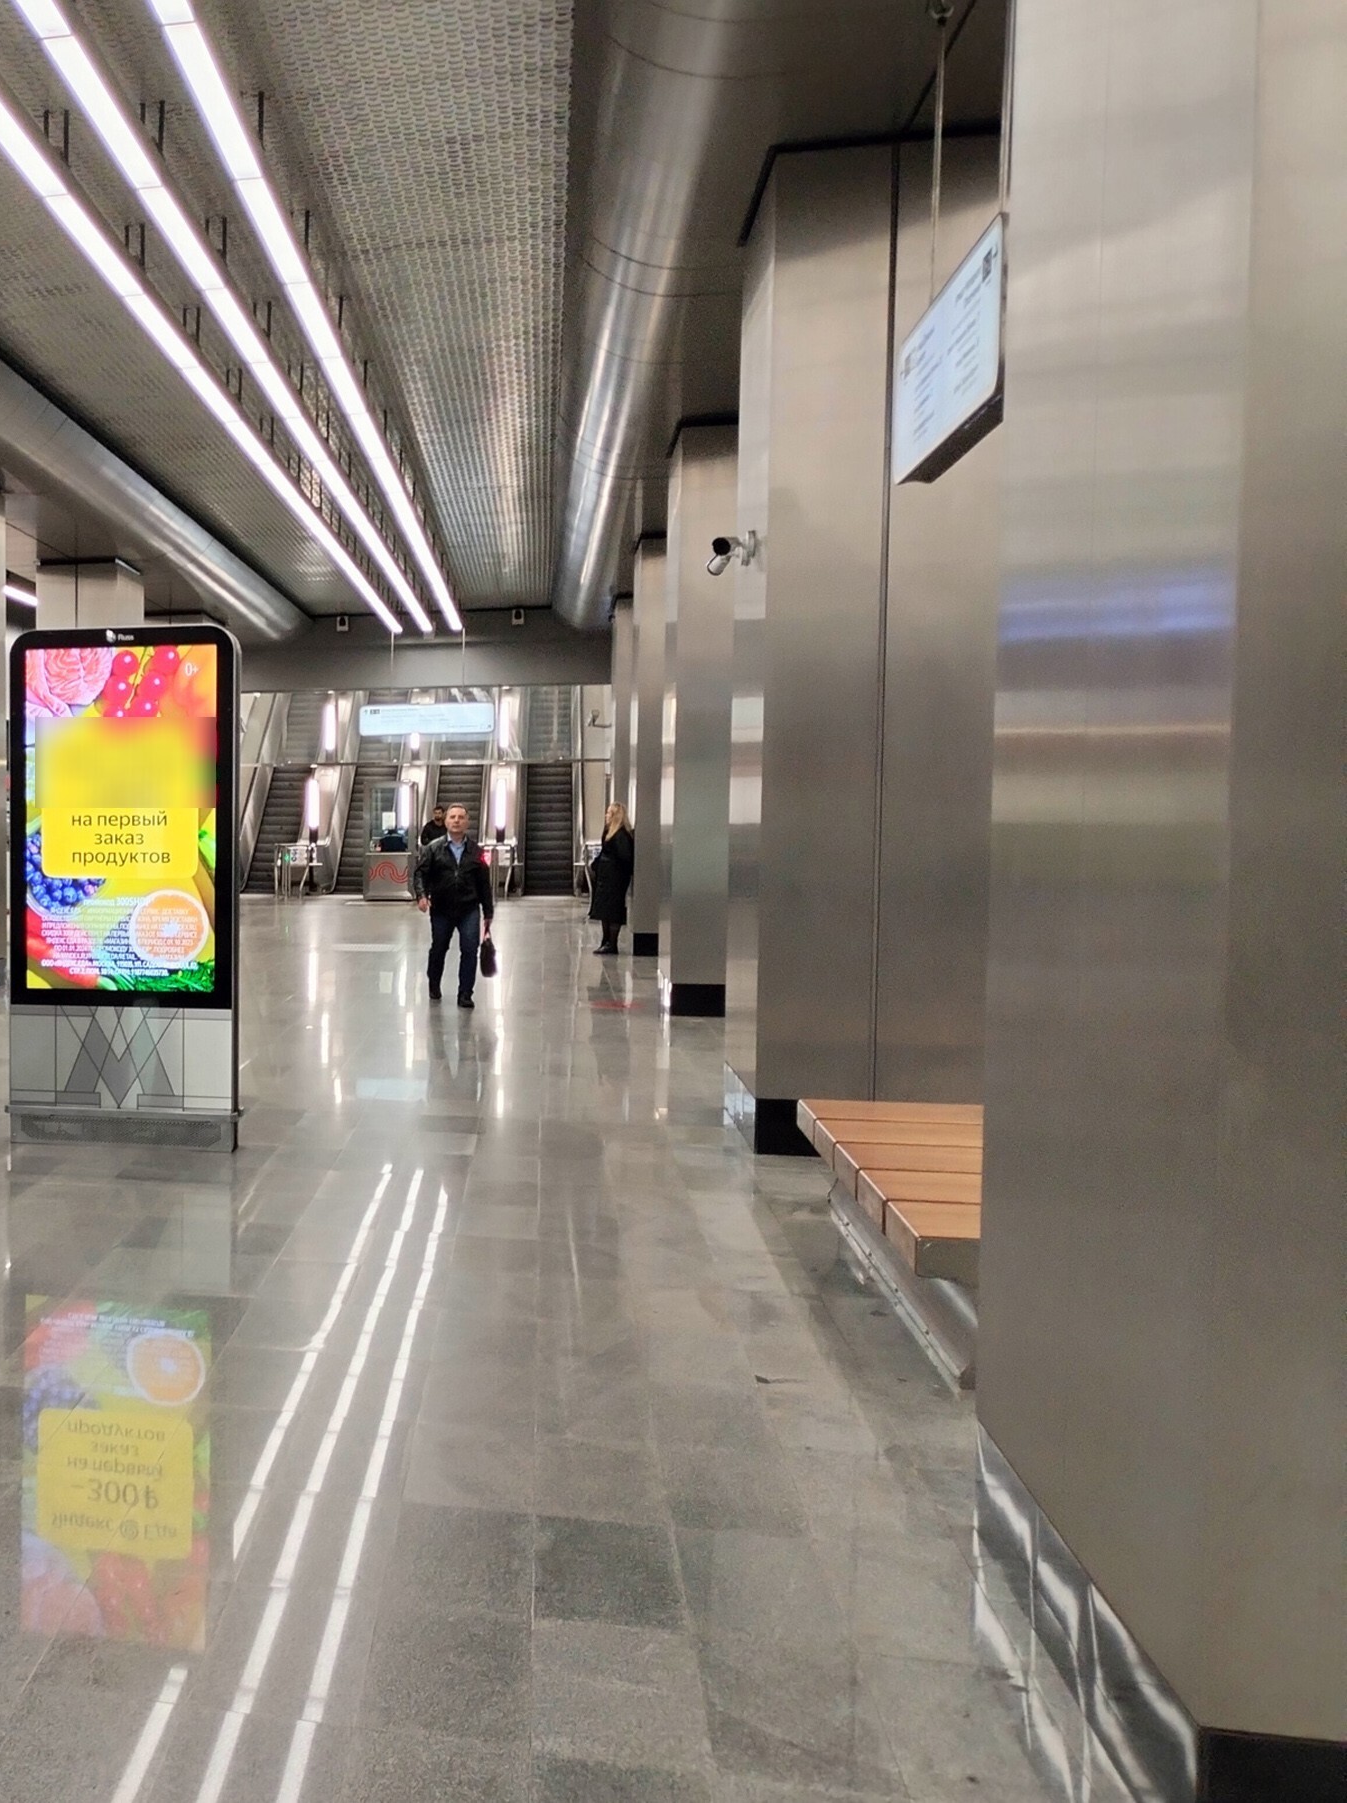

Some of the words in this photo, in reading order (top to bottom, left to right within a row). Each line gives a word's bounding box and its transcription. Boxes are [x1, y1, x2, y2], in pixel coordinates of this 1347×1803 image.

[185, 662, 199, 676] 0+
[71, 814, 93, 827] на
[97, 810, 168, 831] первый
[93, 832, 145, 846] заказ
[71, 851, 171, 868] продуктов
